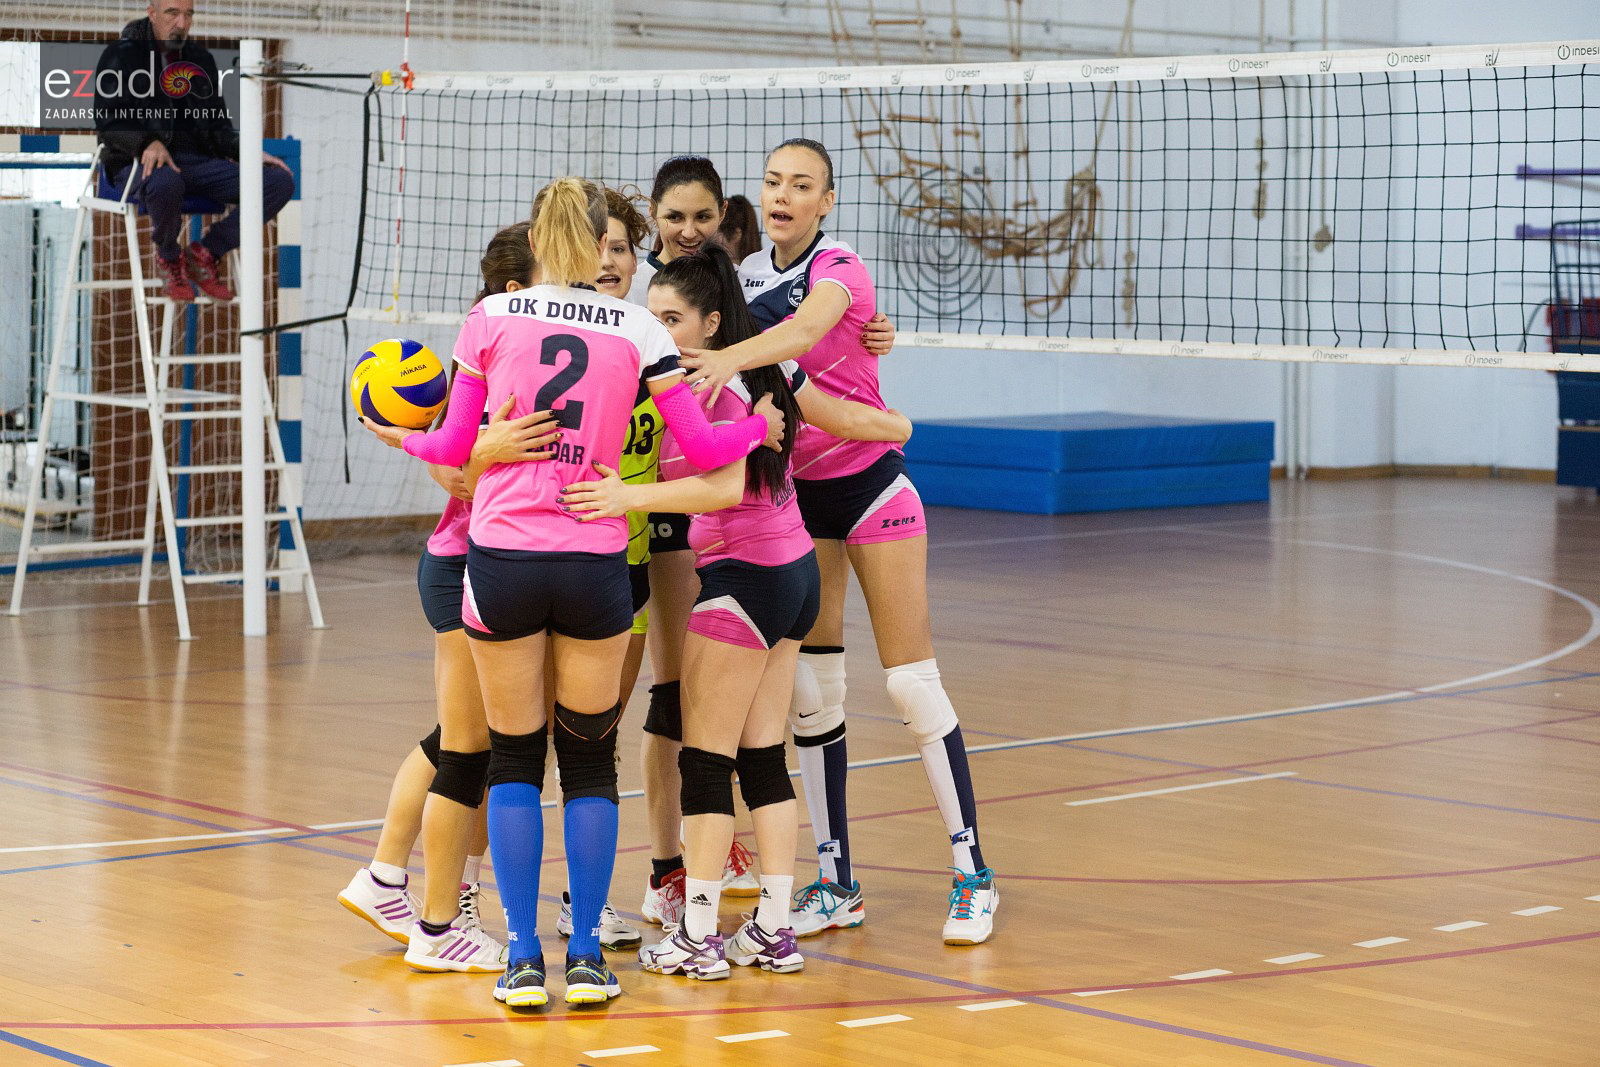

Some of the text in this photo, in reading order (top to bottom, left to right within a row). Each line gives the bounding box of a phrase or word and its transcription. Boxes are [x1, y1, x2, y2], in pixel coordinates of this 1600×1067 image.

[1572, 46, 1600, 56] INDESI
[744, 278, 765, 288] Zeus
[508, 298, 625, 327] OK DONAT
[534, 334, 589, 430] 2
[623, 413, 655, 455] 13
[526, 441, 585, 465] DAR
[881, 516, 916, 528] Zeus
[690, 899, 712, 907] adidas
